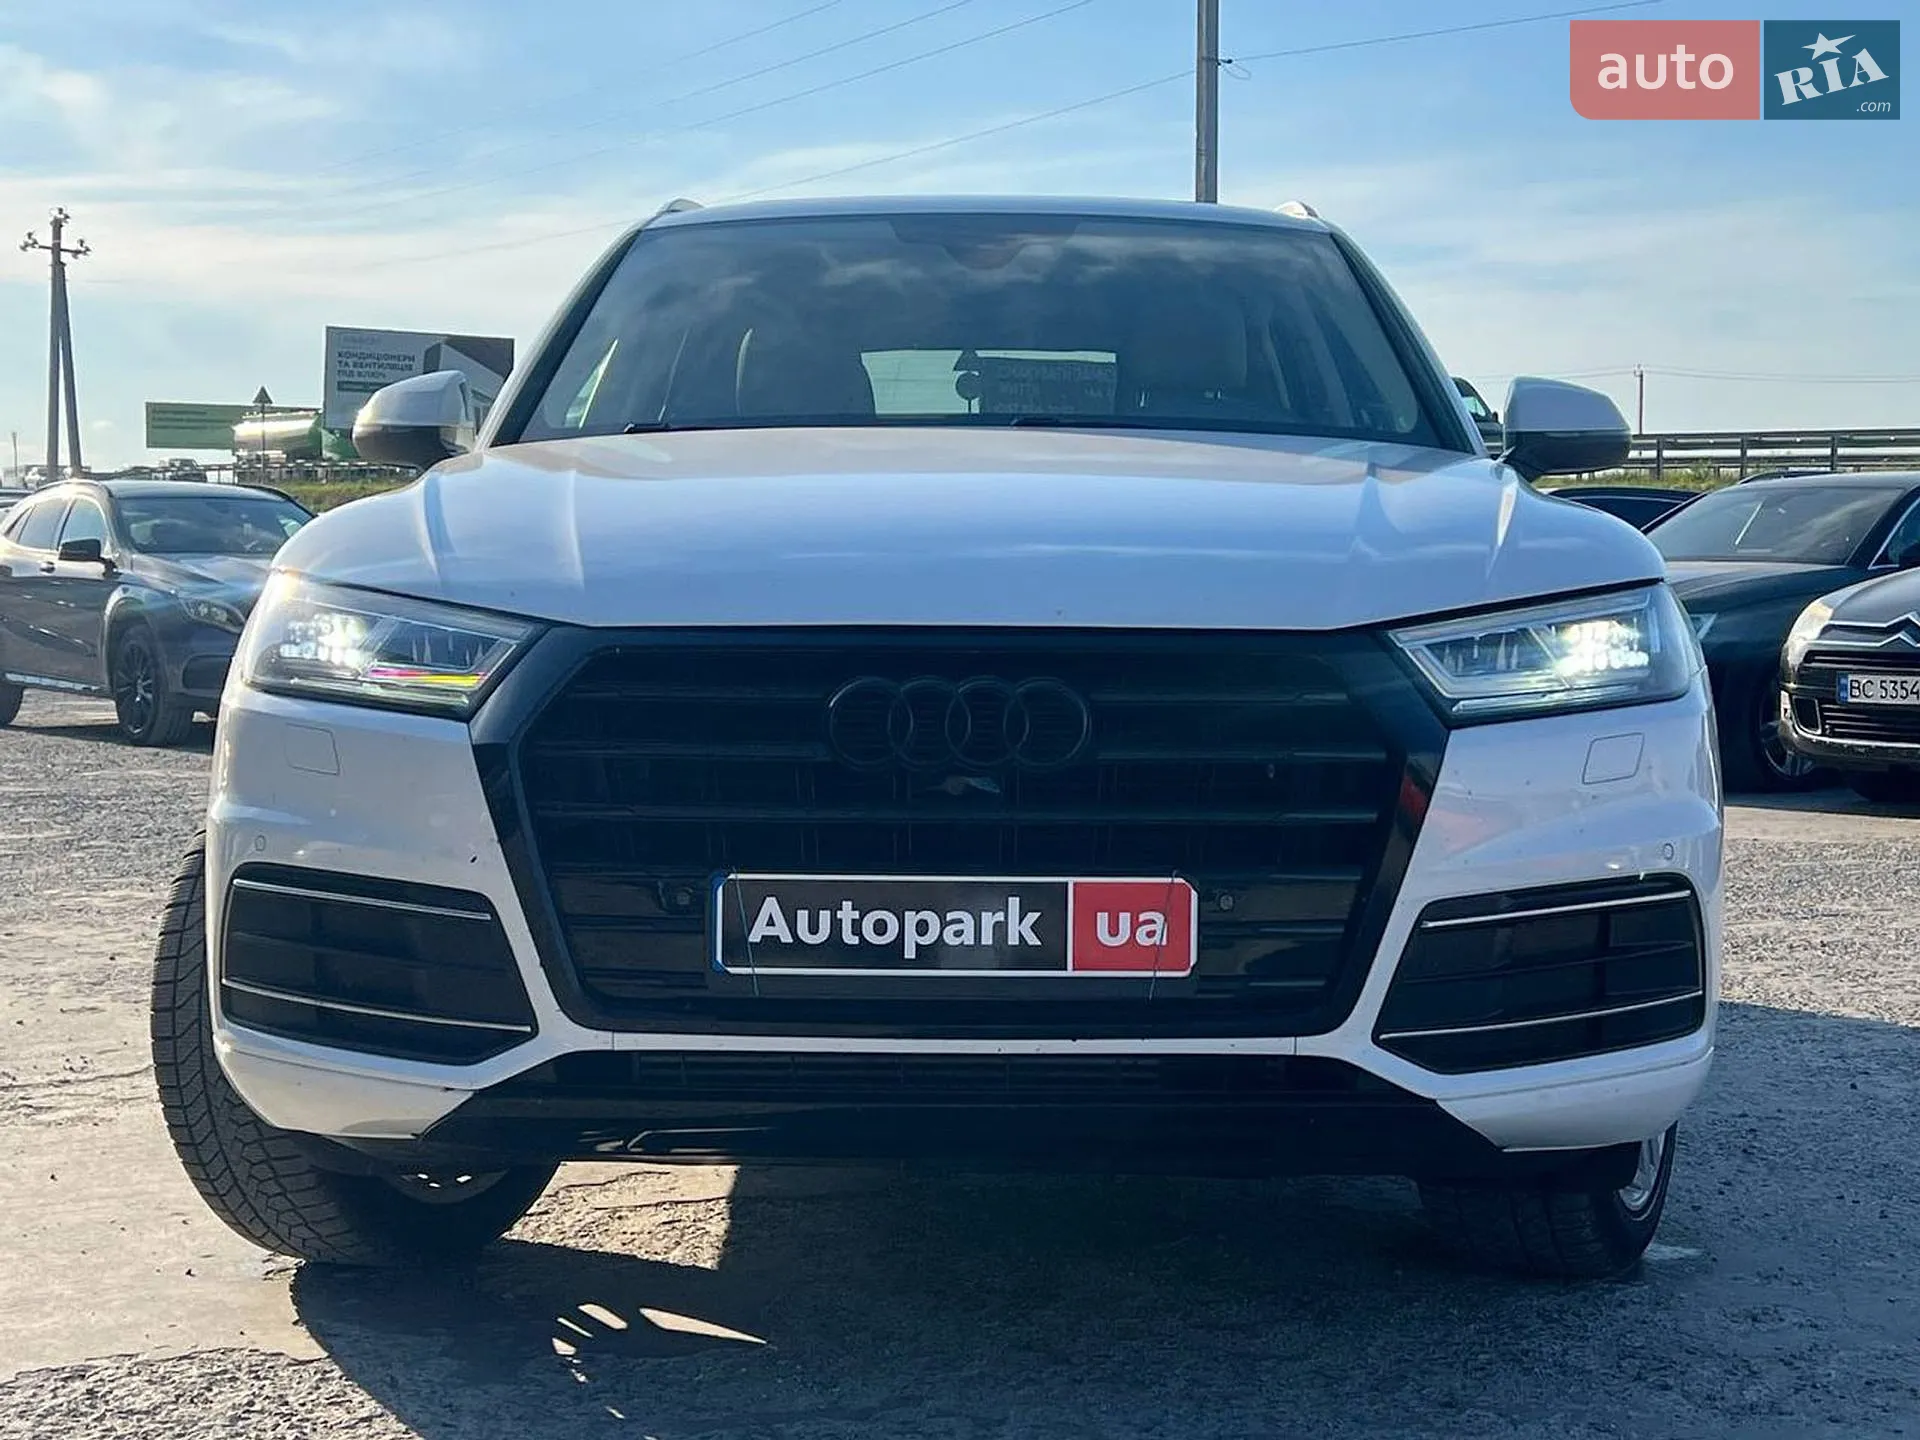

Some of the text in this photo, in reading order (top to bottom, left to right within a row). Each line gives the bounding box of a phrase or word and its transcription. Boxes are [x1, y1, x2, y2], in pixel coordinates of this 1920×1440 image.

[1850, 679, 1920, 700] BC 5354
[748, 896, 1168, 960] Autopark ua
